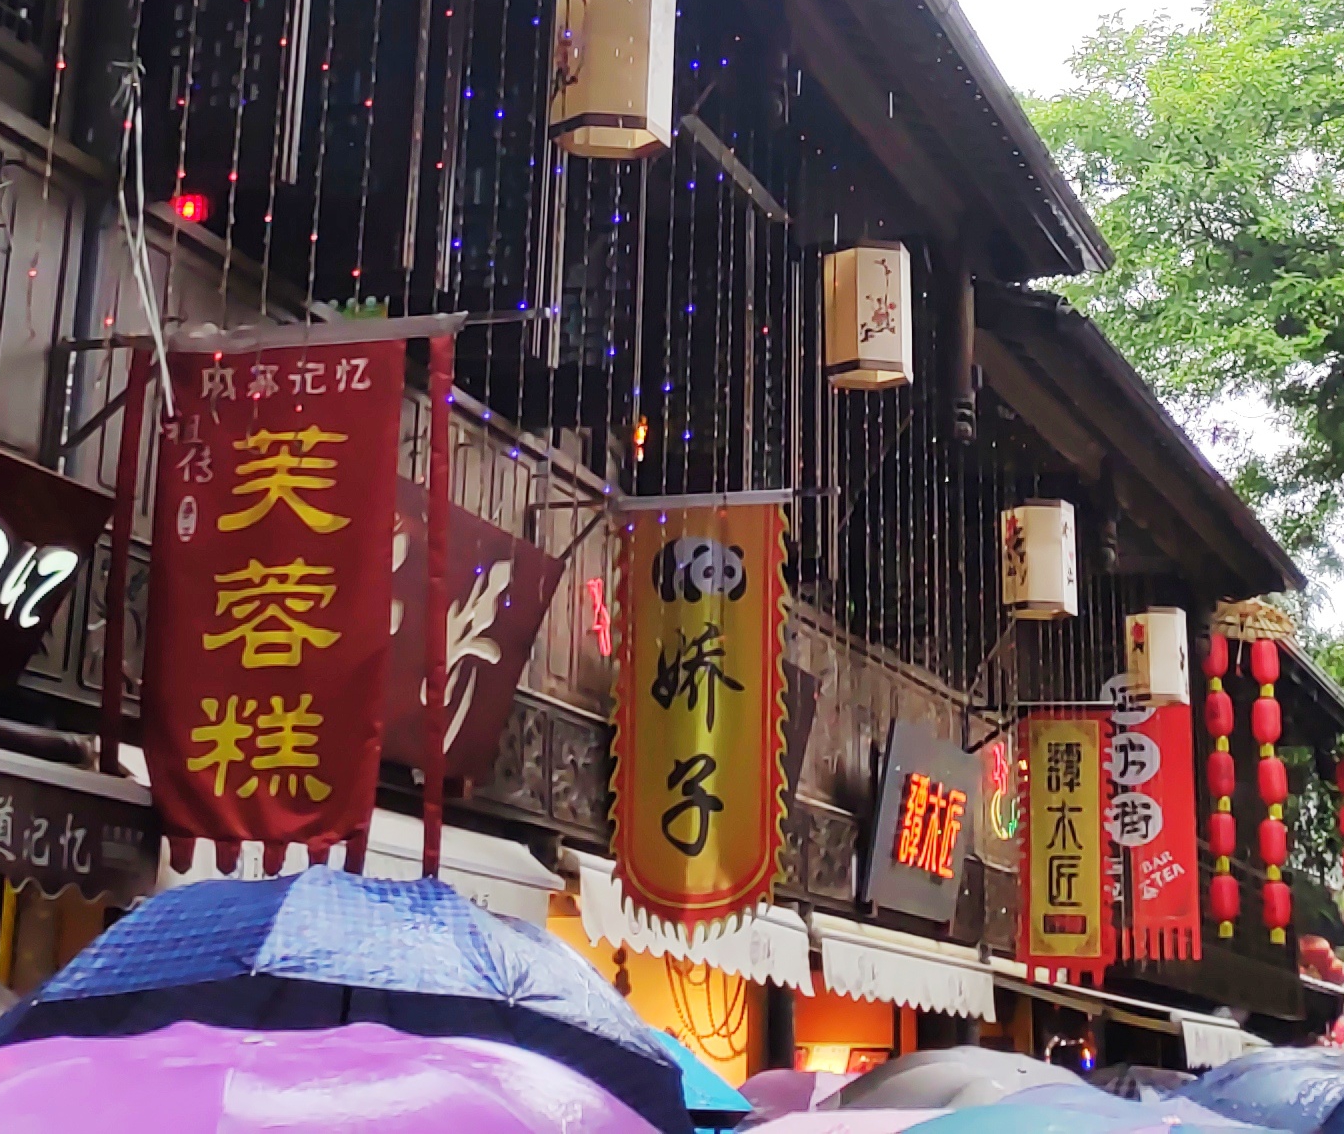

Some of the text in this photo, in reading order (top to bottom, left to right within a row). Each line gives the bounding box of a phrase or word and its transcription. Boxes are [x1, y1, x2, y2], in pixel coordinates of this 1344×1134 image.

[187, 424, 352, 803] 芙蓉糕
[650, 623, 745, 857] 娇子
